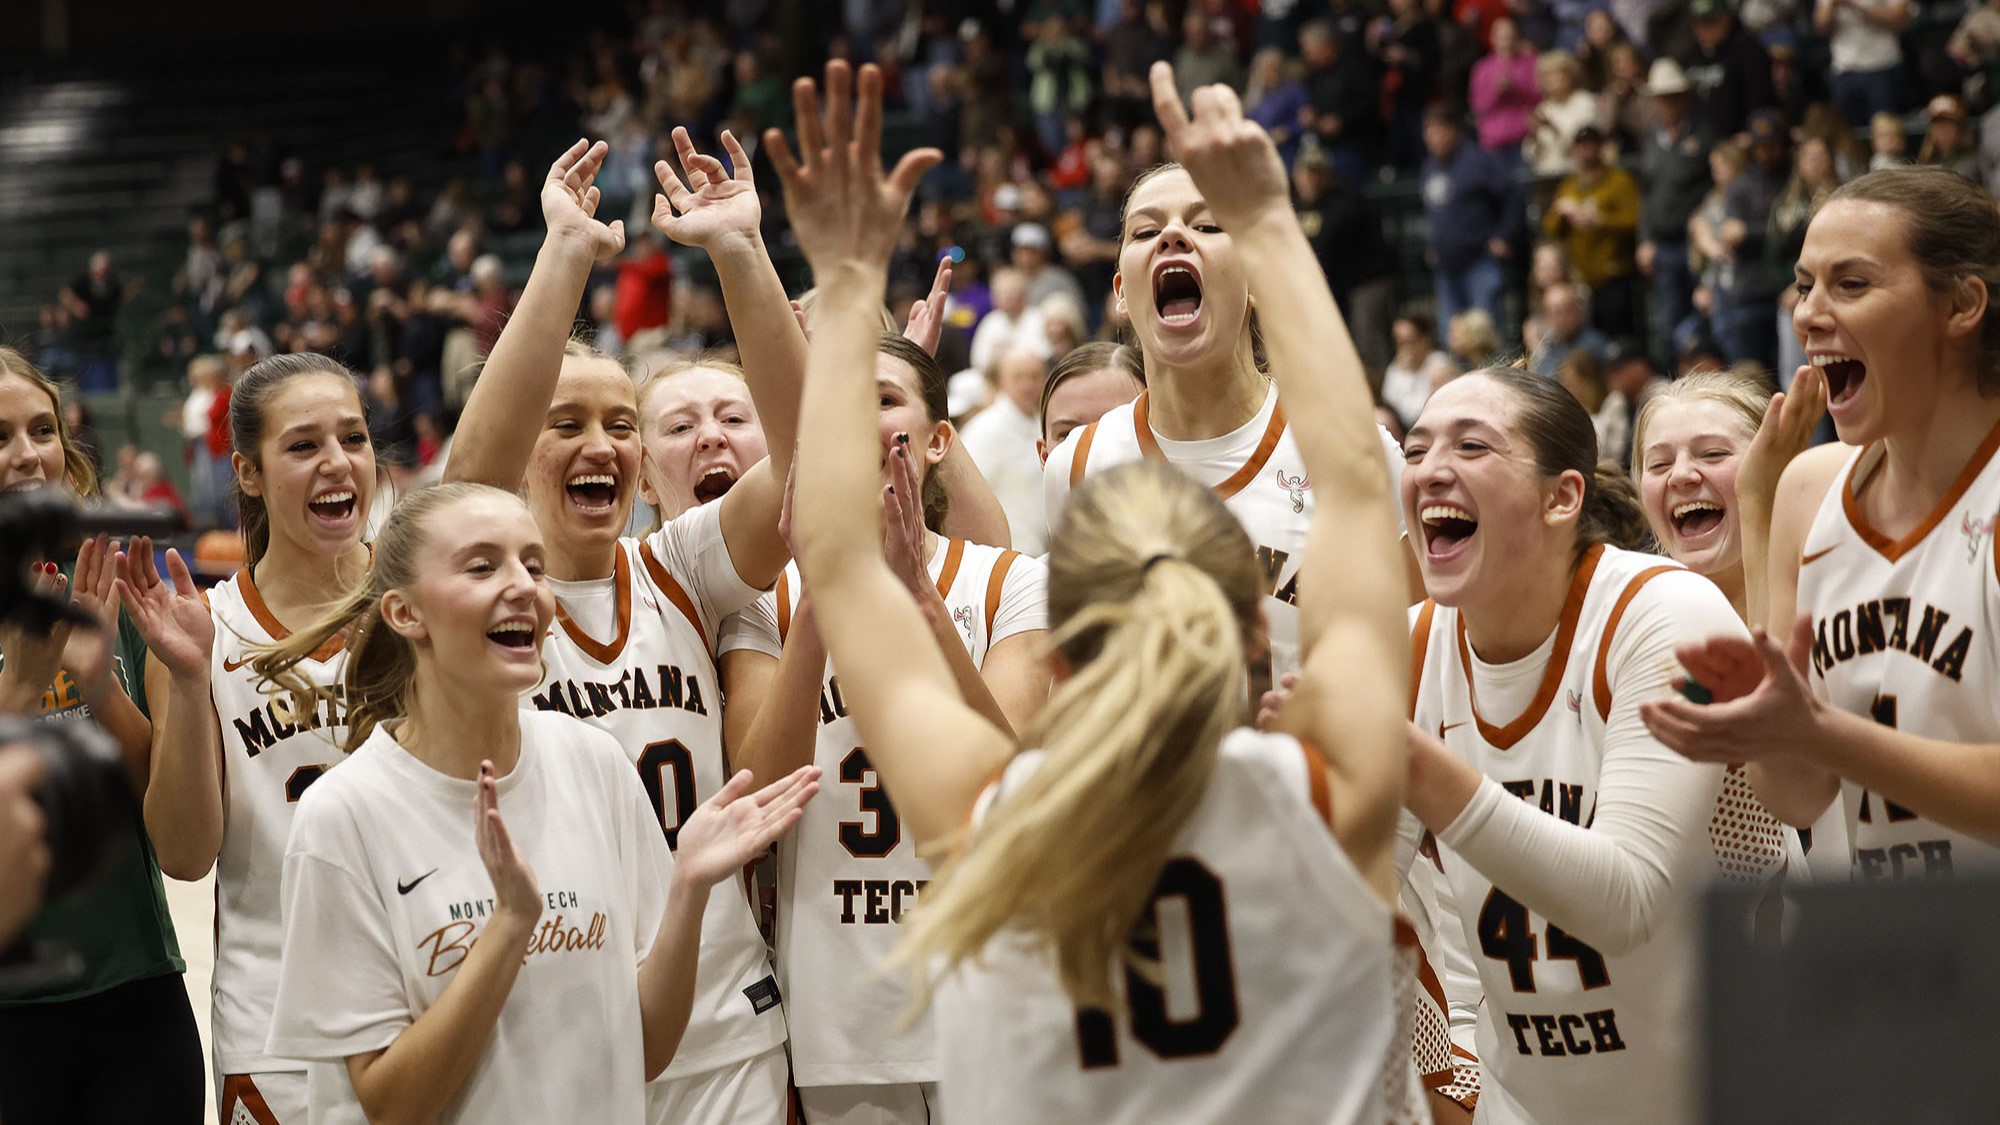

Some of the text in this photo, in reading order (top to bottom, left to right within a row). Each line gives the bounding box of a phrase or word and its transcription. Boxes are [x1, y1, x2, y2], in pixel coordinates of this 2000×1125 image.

[449, 891, 578, 921] MONT ECH
[833, 880, 933, 924] TEC
[1506, 1009, 1626, 1057] TECH
